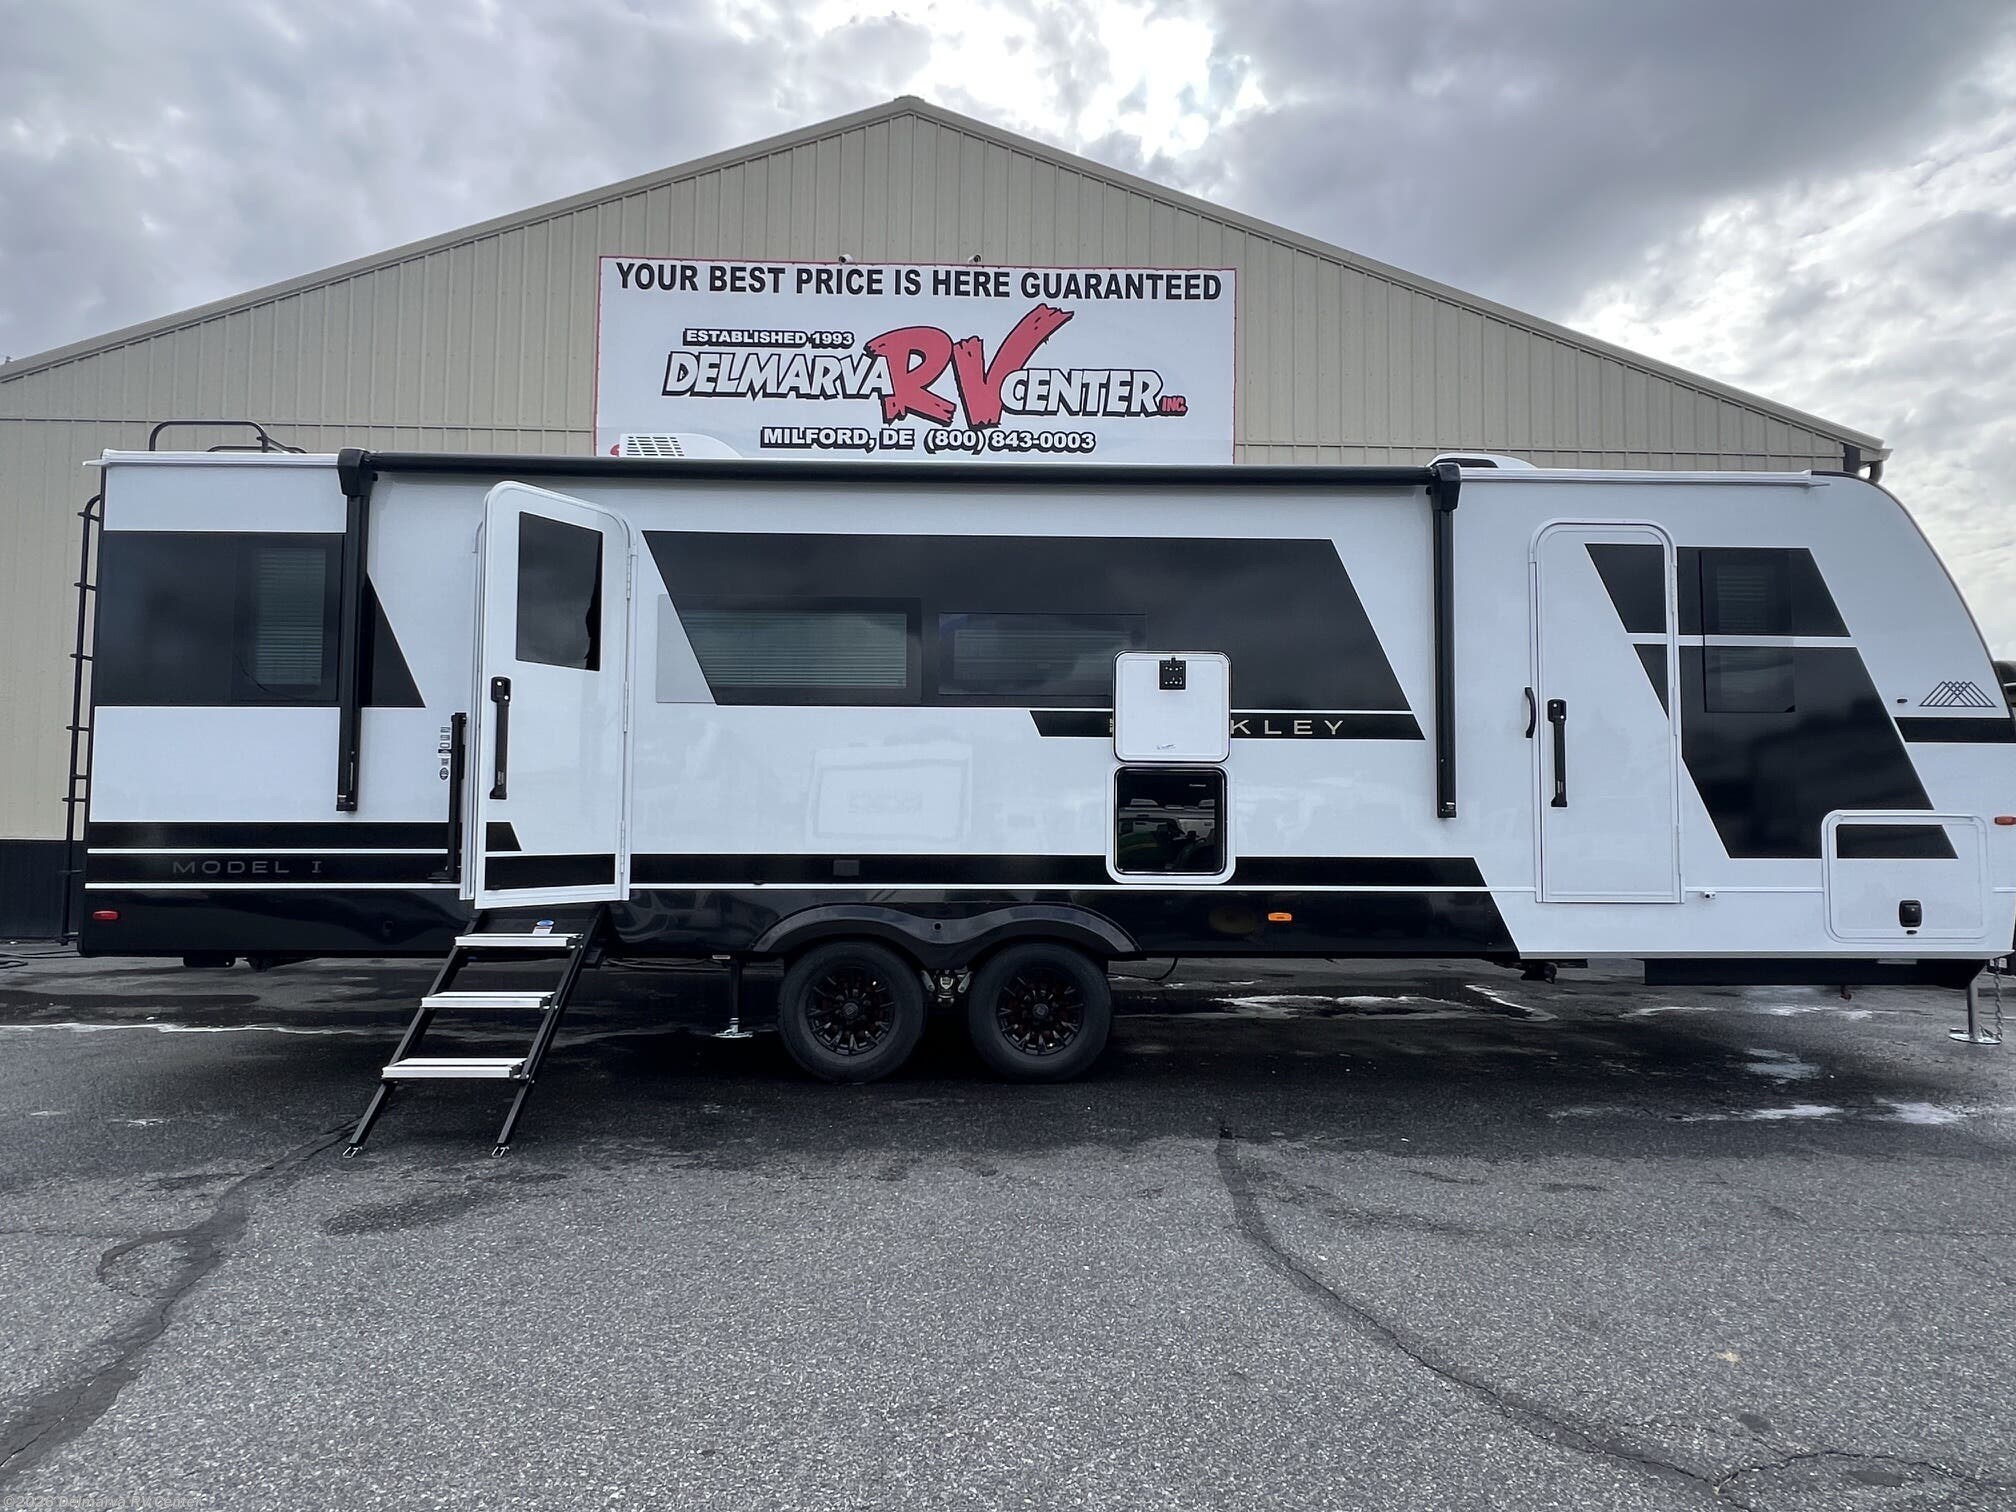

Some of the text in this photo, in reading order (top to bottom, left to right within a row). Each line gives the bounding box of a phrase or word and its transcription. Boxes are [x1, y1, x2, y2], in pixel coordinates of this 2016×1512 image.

[616, 262, 1222, 300] YOUR BEST PRICE IS HERE GUARANTEED
[684, 329, 855, 348] ESTABLISHED 1993
[662, 303, 1187, 429] DELMARVA RV CENTER INC.
[761, 427, 1097, 454] MILFORD, DE (800) 843-0003
[172, 860, 322, 874] MODEL I
